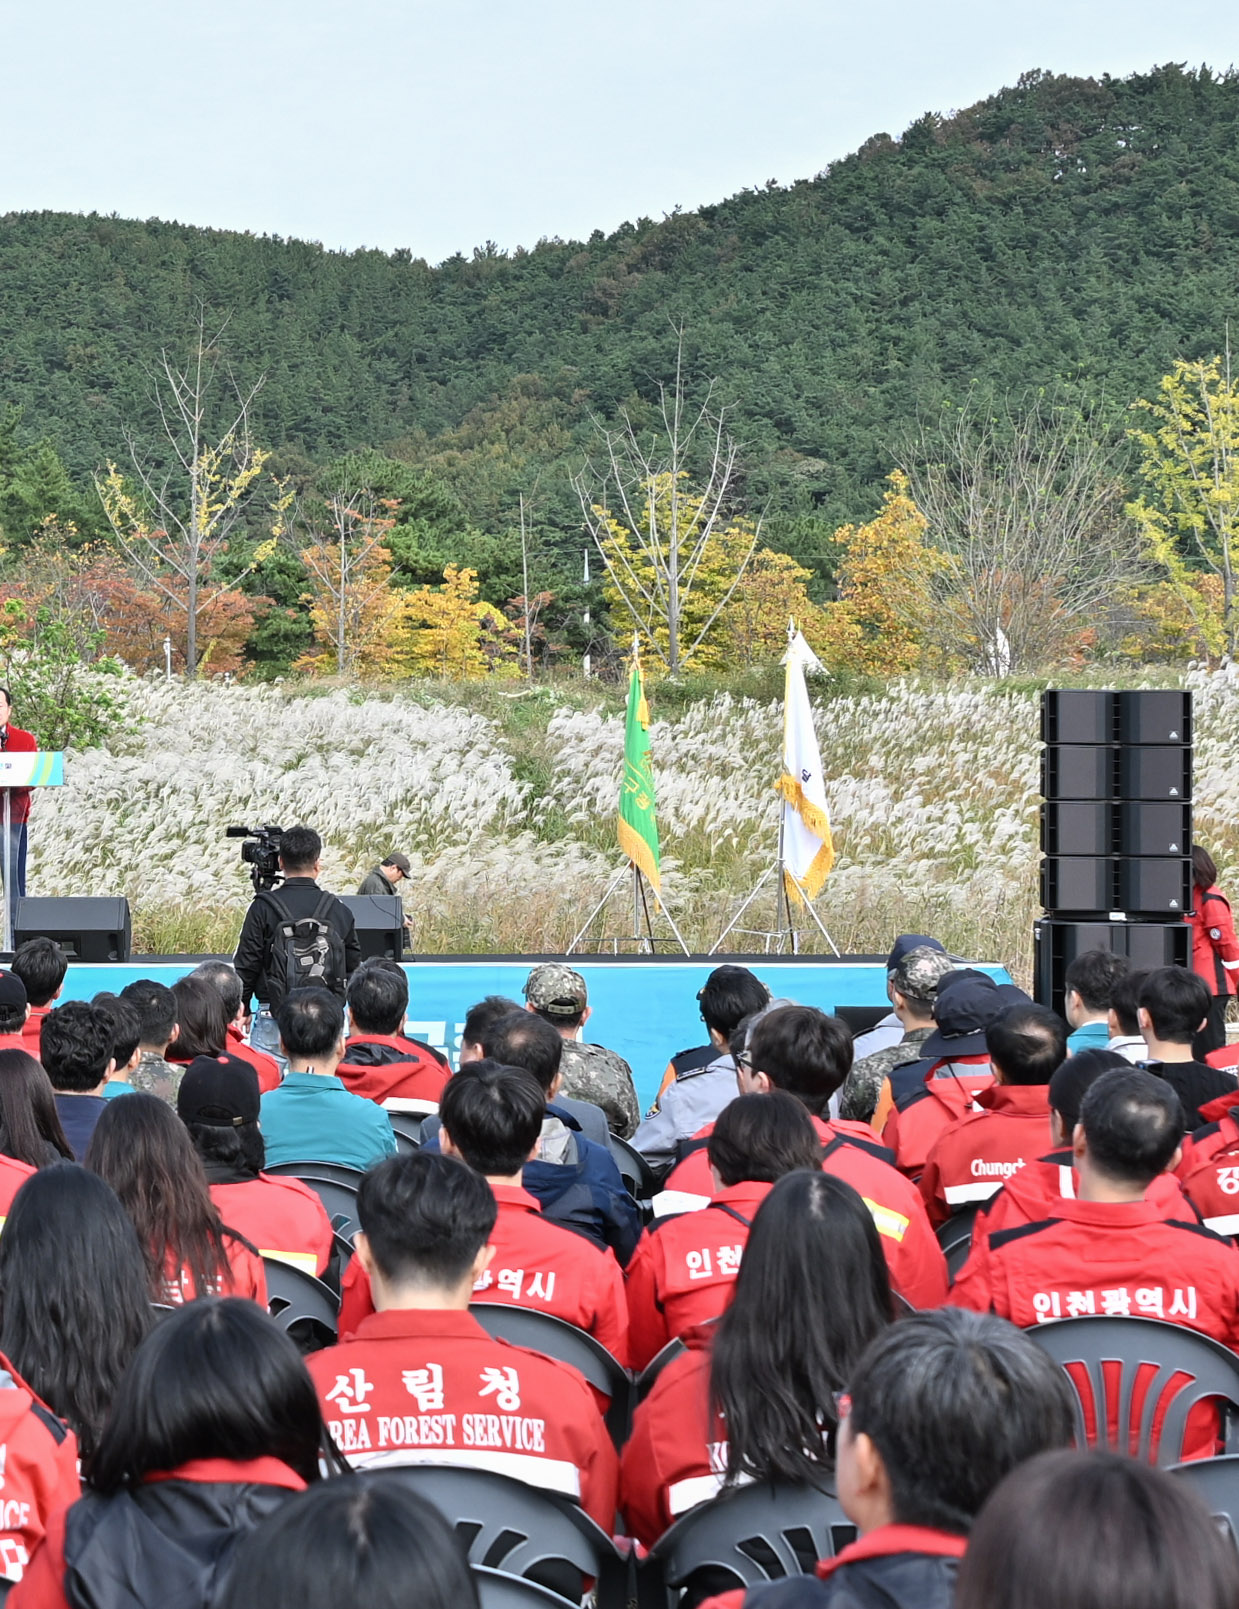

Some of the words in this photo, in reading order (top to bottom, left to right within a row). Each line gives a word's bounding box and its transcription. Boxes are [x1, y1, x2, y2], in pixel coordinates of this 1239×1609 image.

[1032, 1286, 1198, 1324] 인천광역시
[328, 1418, 372, 1451] REA
[377, 1413, 457, 1447] FOREST
[462, 1413, 546, 1453] SERVICE
